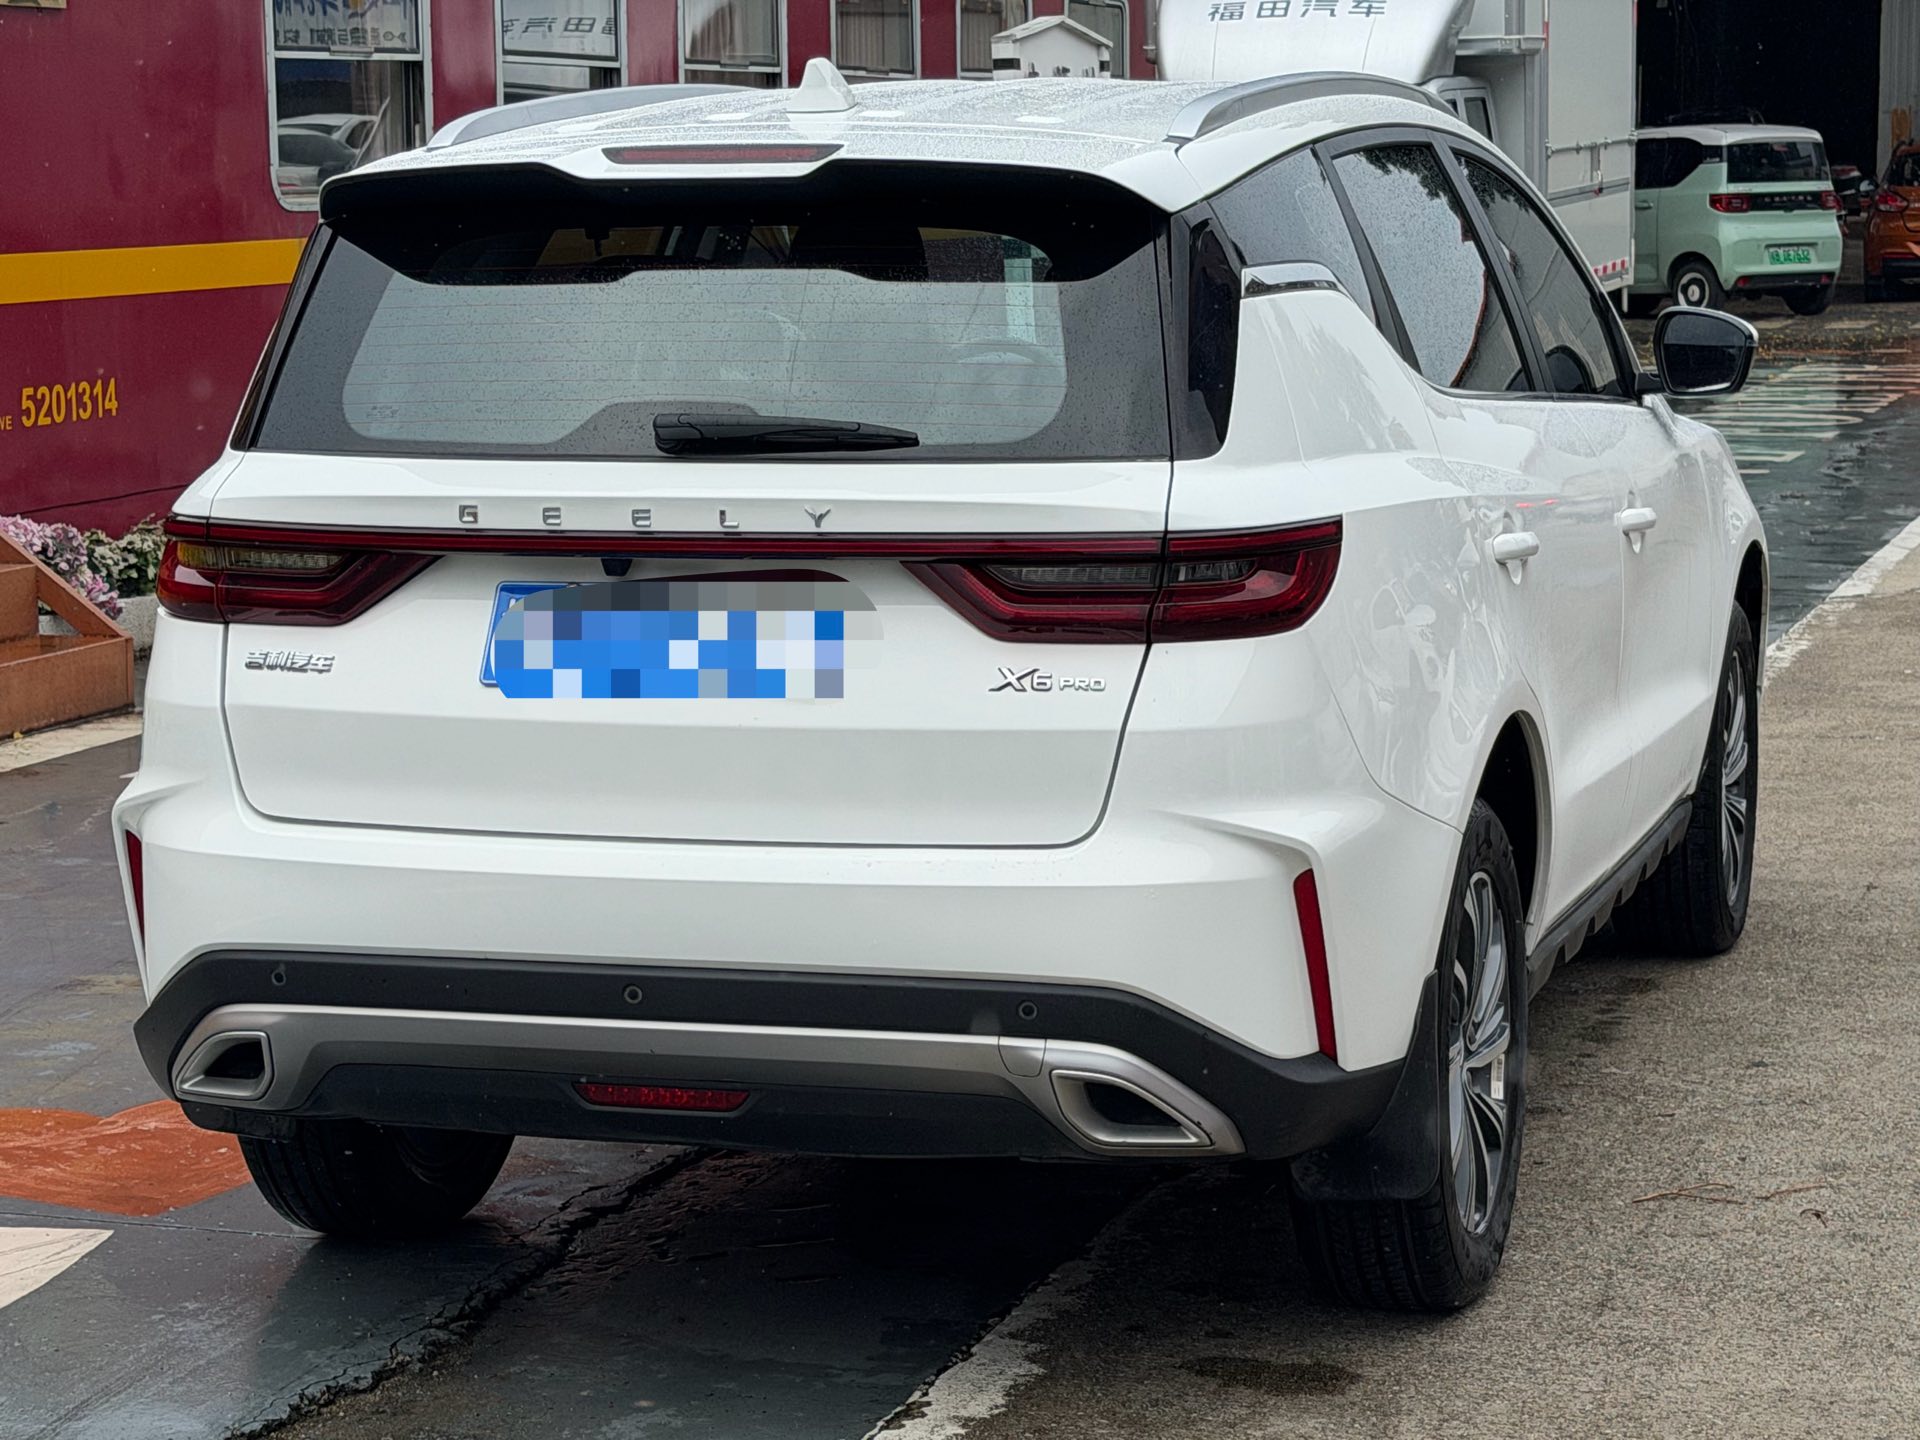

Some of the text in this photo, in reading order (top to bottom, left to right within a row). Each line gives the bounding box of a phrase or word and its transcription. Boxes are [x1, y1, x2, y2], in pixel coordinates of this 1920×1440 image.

[1207, 0, 1387, 22] 福田汽车
[21, 377, 118, 427] 5201314
[458, 504, 831, 529] GEELY
[245, 651, 335, 674] 吉利汽车
[988, 667, 1106, 692] X6 PRO
